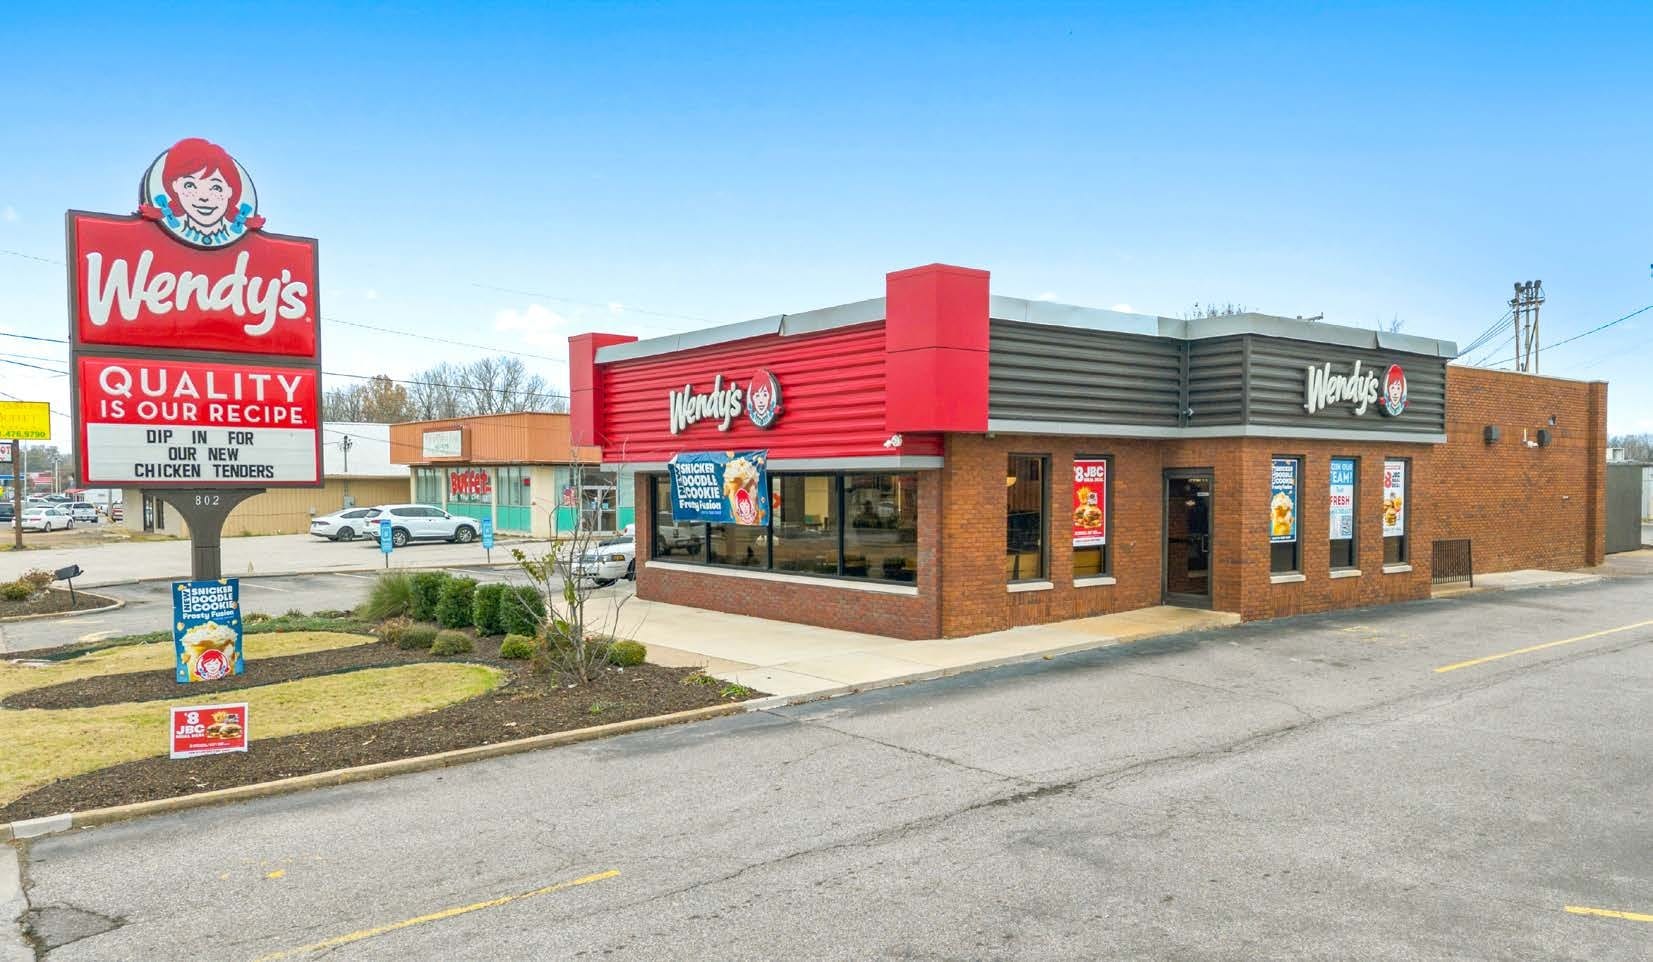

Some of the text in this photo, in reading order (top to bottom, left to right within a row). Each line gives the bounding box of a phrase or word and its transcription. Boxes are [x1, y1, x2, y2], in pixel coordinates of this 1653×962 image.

[86, 250, 308, 337] Wendy's
[99, 366, 302, 403] QUALITY
[1308, 360, 1379, 416] Wendy's
[101, 399, 126, 419] IS
[137, 401, 197, 421] OUR
[669, 374, 743, 435] Wendy's
[146, 429, 254, 445] DIP IN FOR
[168, 447, 239, 461] OUR NEW
[134, 463, 275, 478] CHICKEN TENDERS
[680, 463, 715, 474] SNICKER
[1084, 466, 1104, 477] JBC
[682, 475, 718, 486] DOODLE
[684, 487, 720, 499] COOKIE
[195, 496, 219, 505] 802
[192, 585, 233, 595] SNICKER
[192, 593, 233, 604] DOODLE
[192, 602, 234, 612] COOKIE
[211, 610, 234, 618] Fusion
[176, 725, 205, 735] JBC
